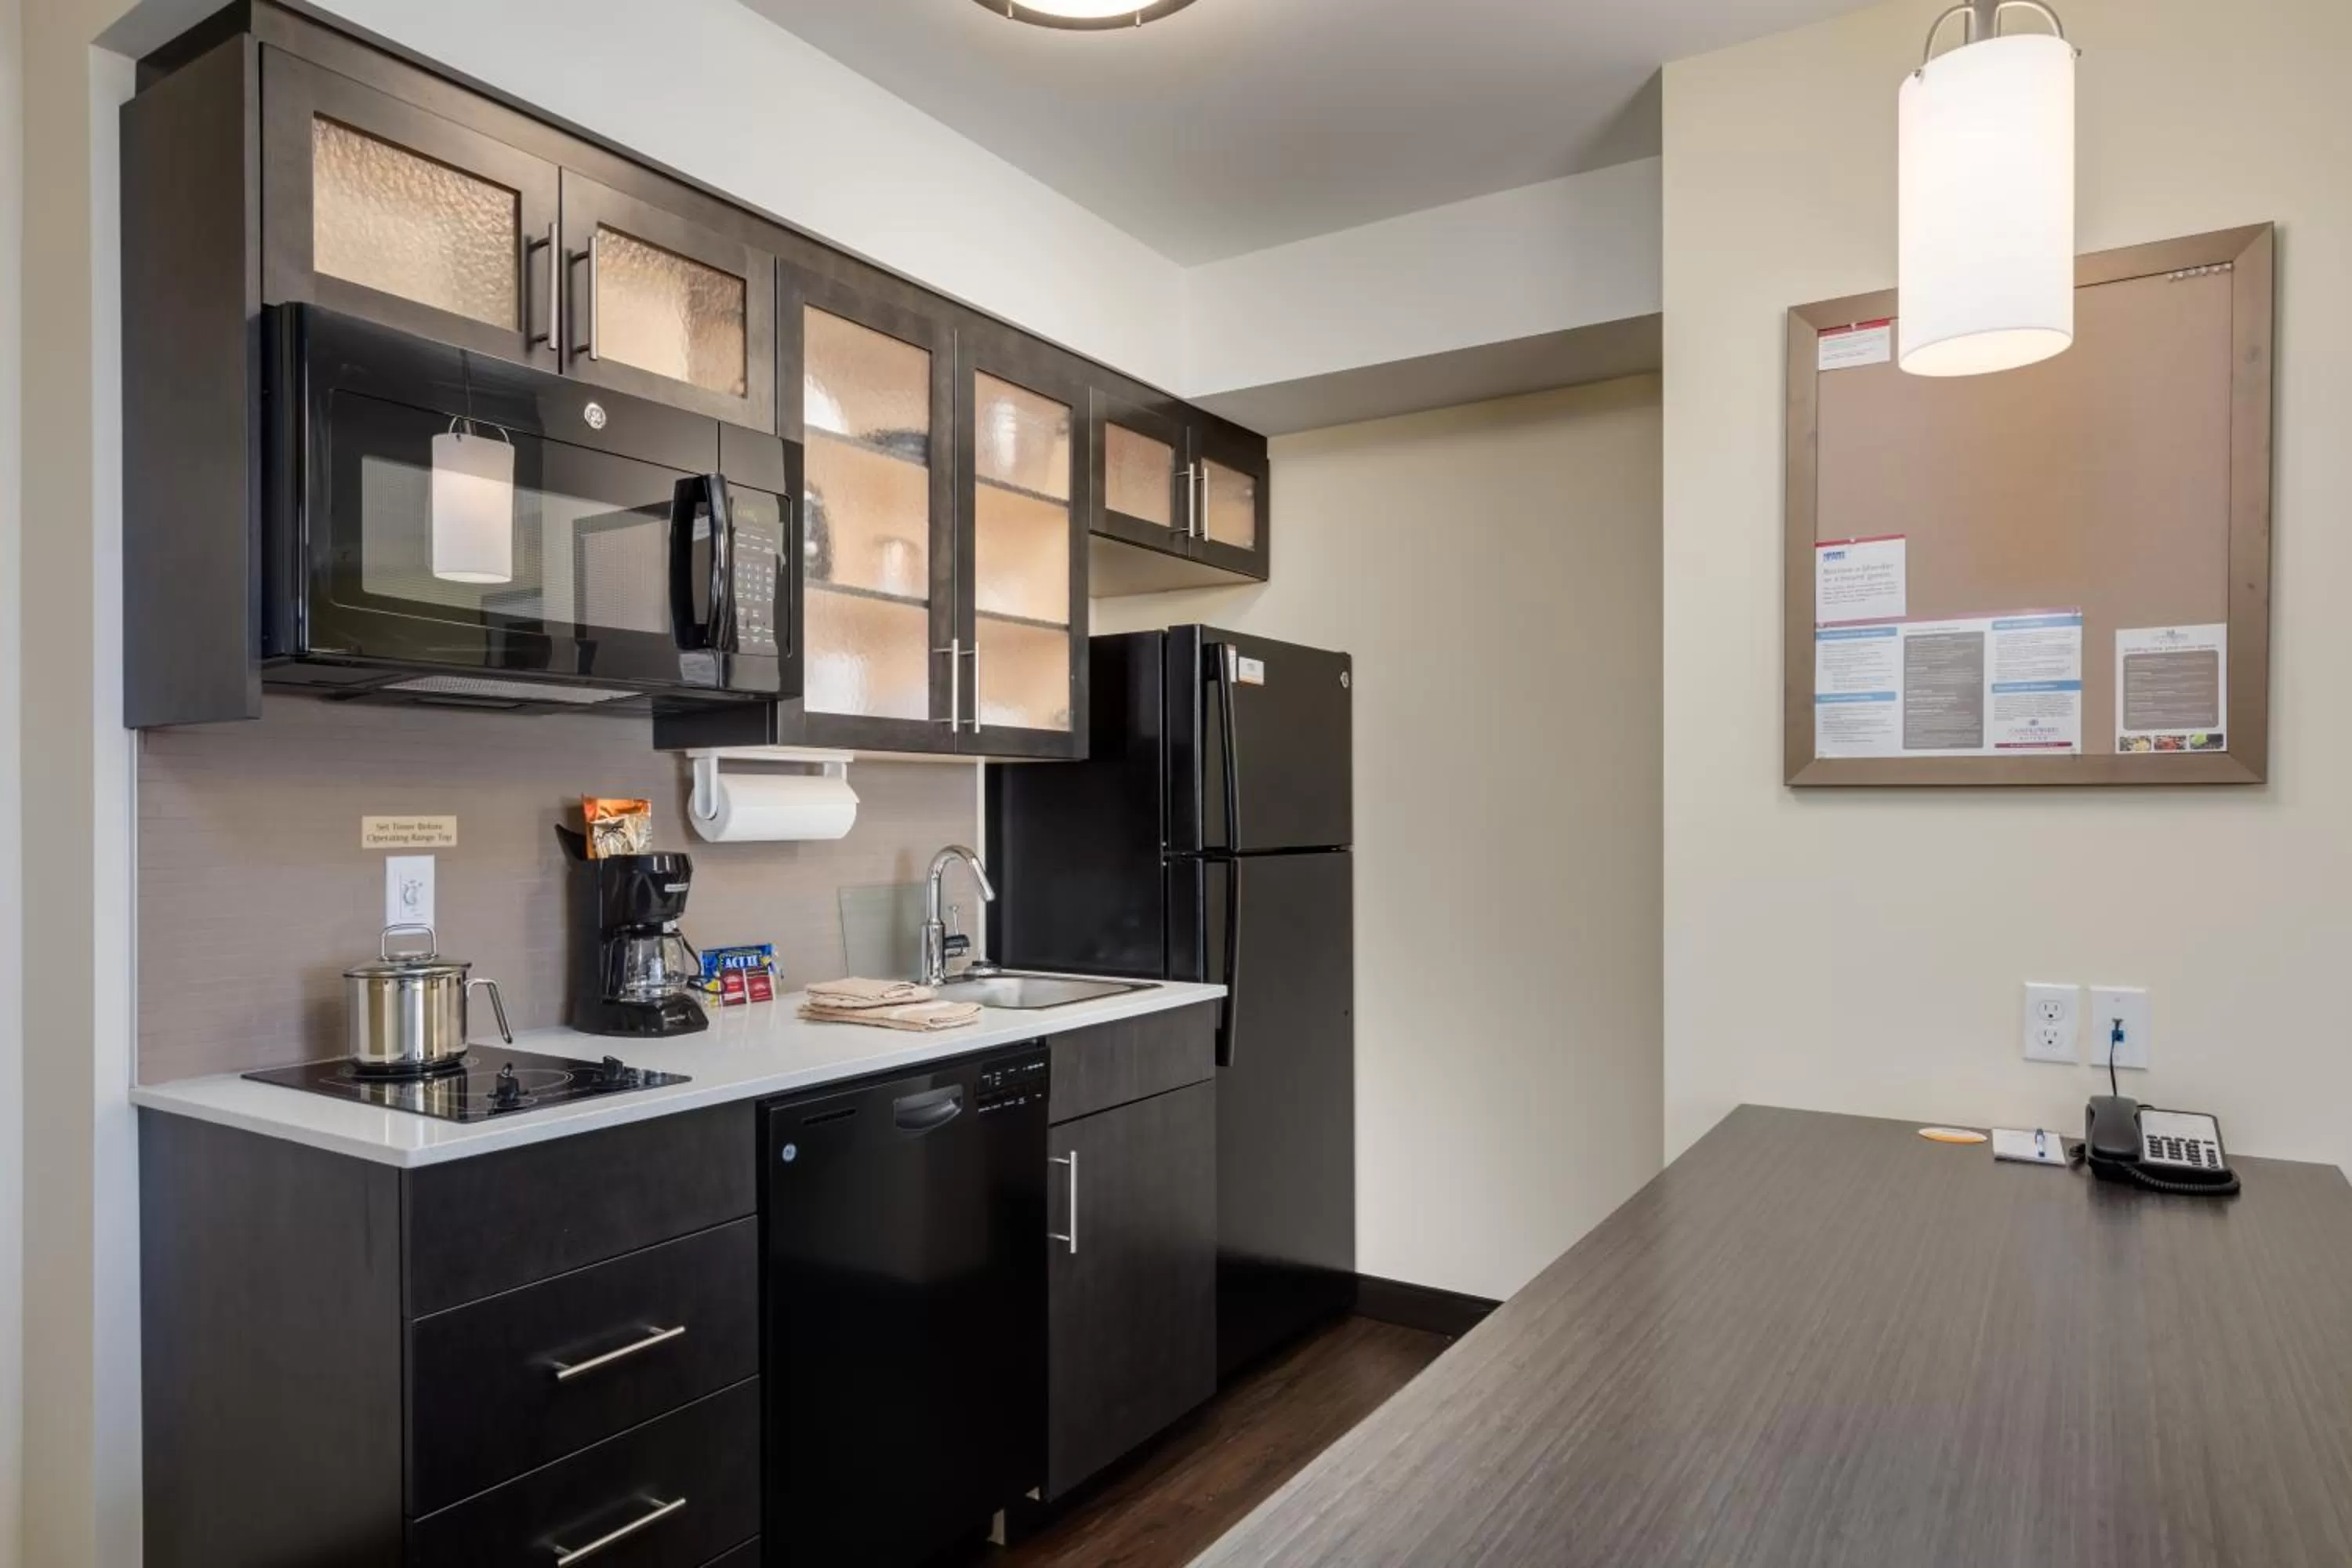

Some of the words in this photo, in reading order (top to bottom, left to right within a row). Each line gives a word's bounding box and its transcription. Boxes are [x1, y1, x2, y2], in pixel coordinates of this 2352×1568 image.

[393, 821, 415, 830] Timer
[417, 821, 443, 830] Before
[366, 833, 409, 844] Operating
[411, 833, 437, 844] Range
[438, 833, 452, 844] Top
[725, 956, 746, 967] ACT
